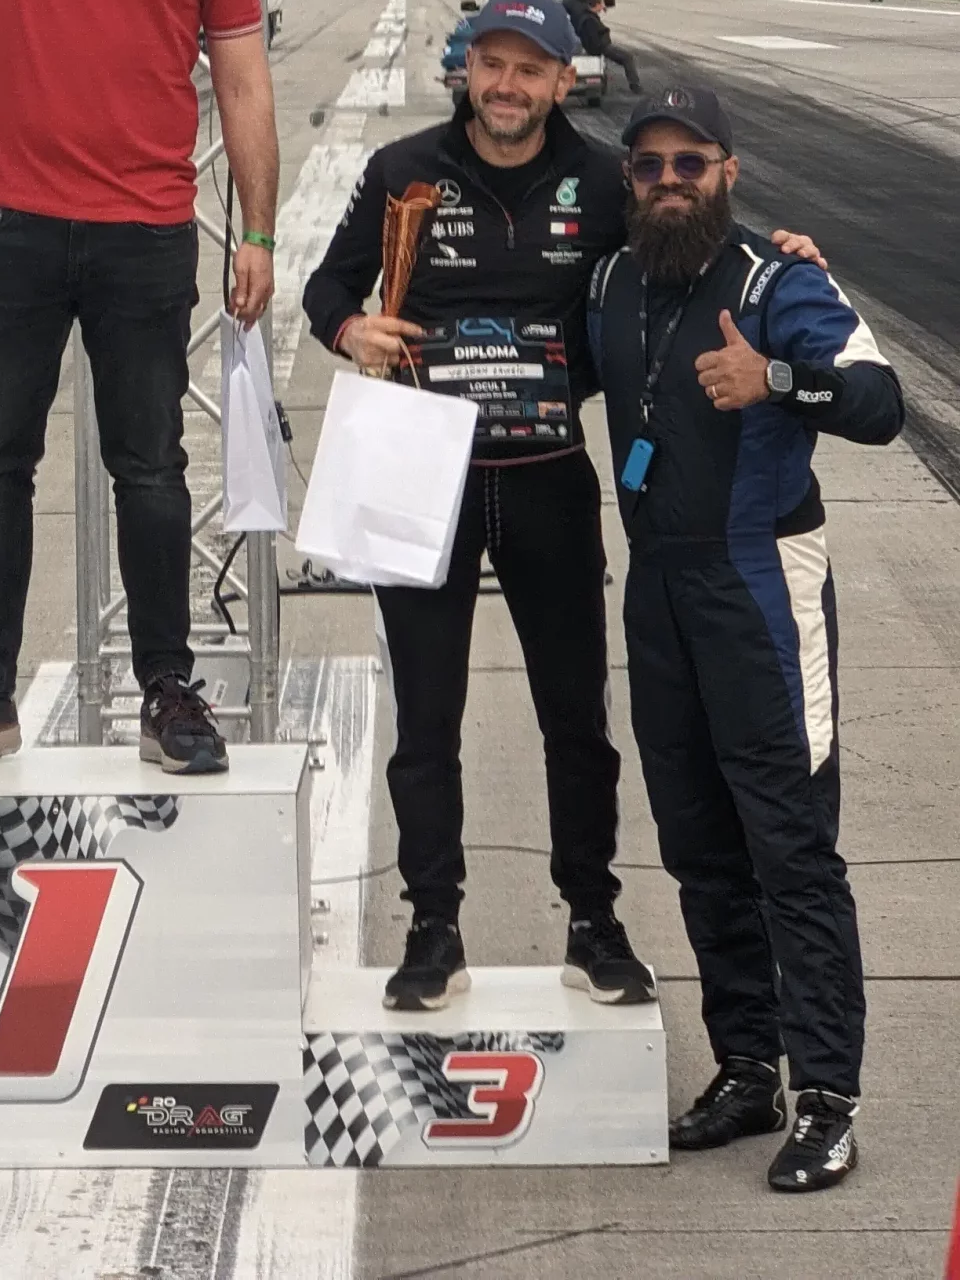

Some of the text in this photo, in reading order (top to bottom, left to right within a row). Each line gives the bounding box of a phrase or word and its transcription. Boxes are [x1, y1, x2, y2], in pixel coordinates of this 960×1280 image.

[448, 221, 474, 237] UBS
[748, 261, 782, 306] sparco
[454, 345, 519, 360] DIPLOMA
[469, 381, 499, 392] LOCUL
[796, 389, 833, 403] spaco
[153, 1096, 176, 1108] RO
[422, 1051, 545, 1148] 3
[138, 1105, 253, 1136] DRAG
